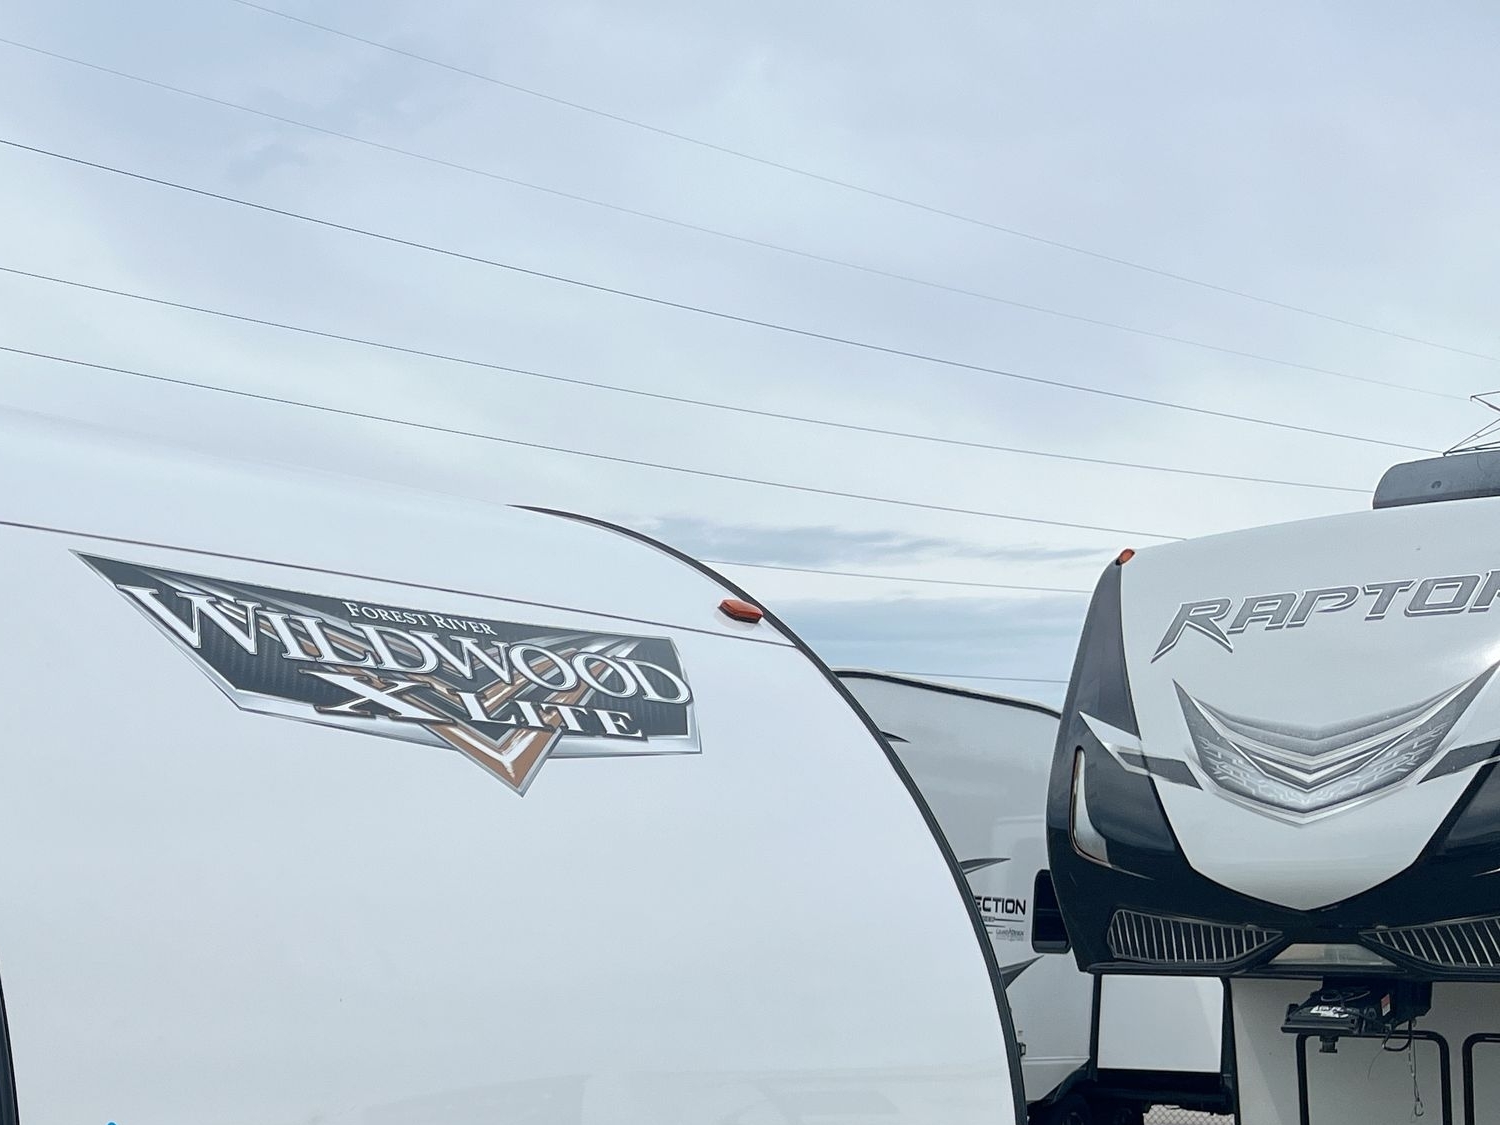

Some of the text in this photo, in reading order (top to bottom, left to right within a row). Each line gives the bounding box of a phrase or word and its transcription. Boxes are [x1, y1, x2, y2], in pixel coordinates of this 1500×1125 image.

[116, 583, 691, 704] WILDWOOD
[342, 601, 498, 636] FOREST RIVER
[299, 669, 643, 739] X LITE
